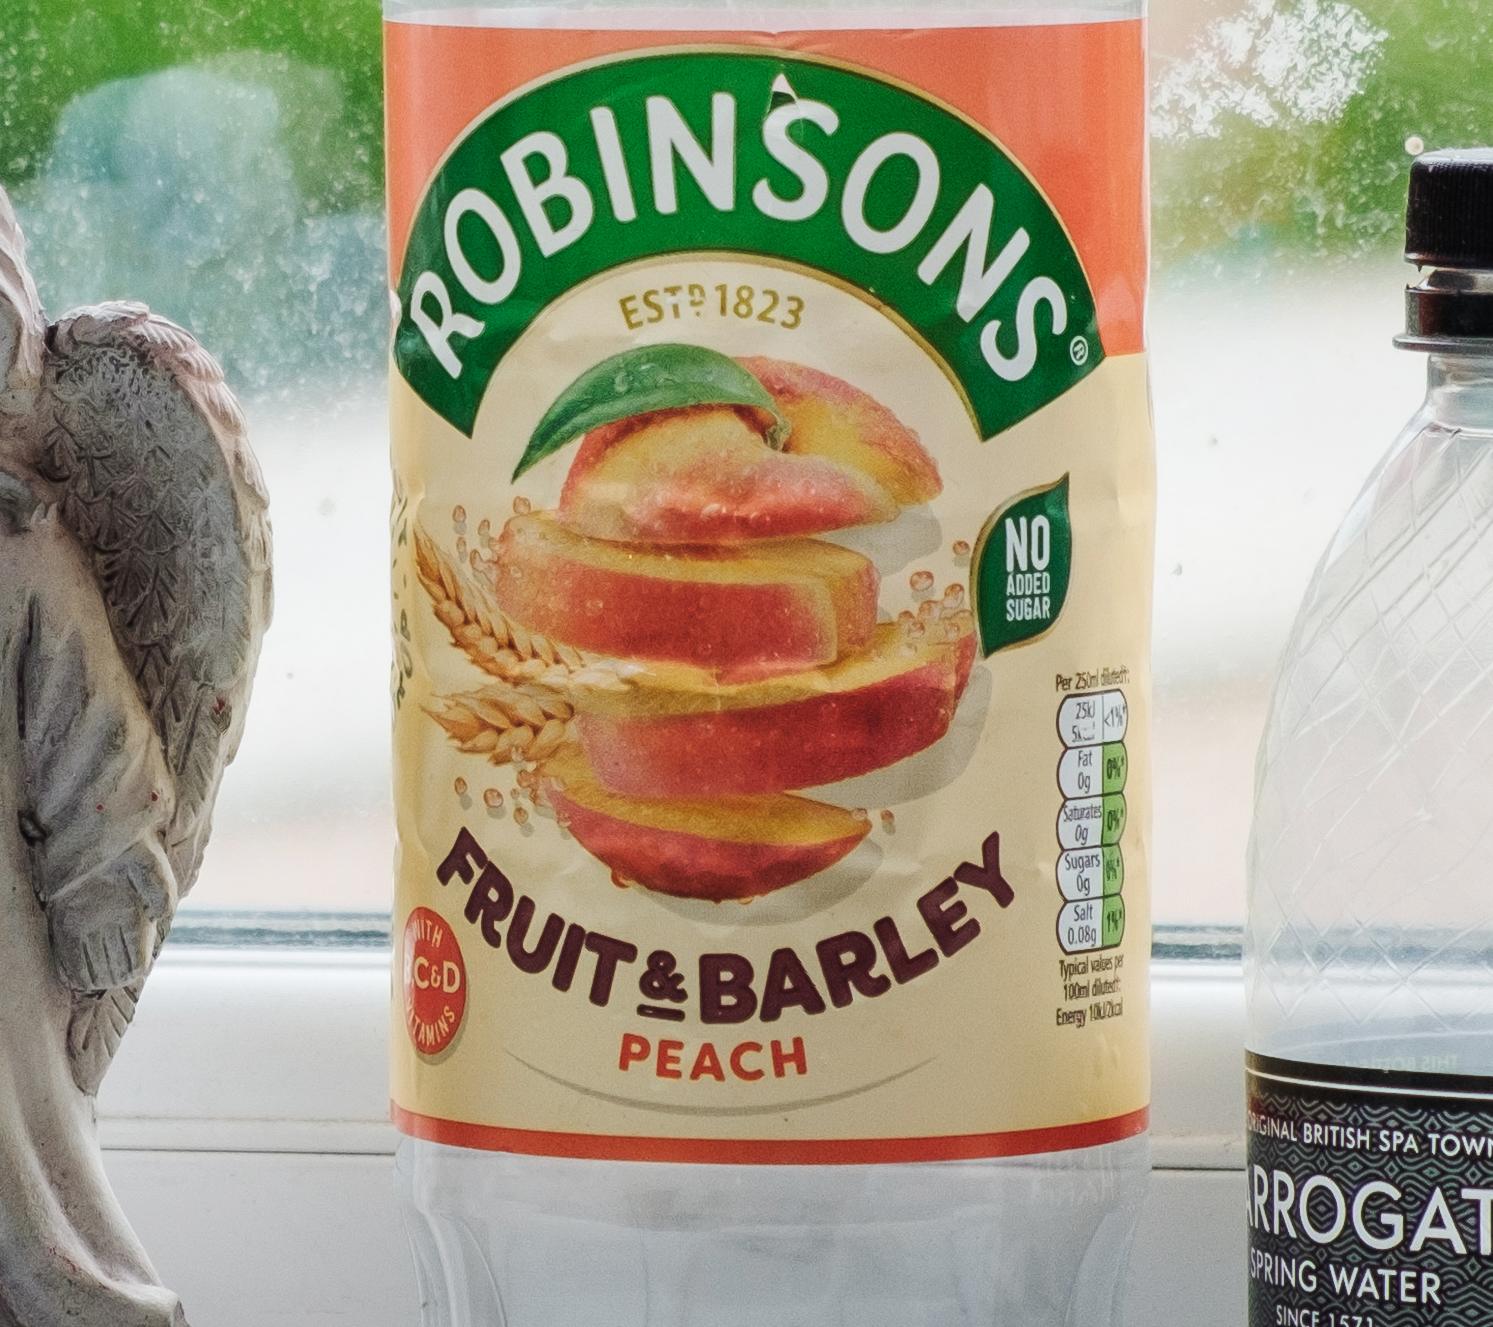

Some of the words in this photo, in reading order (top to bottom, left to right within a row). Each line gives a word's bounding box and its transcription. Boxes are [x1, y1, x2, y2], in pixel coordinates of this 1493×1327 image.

[410, 90, 1068, 382] ROBINSONS
[714, 283, 806, 331] 1823
[1004, 515, 1052, 573] NO
[1004, 571, 1051, 597] ADDED
[1004, 596, 1052, 622] SUGAR
[1056, 673, 1073, 692] Per
[1076, 700, 1096, 720] 25kJ
[1077, 750, 1093, 768] Fat
[1077, 772, 1091, 794] 0g
[1063, 804, 1103, 822] Saturates
[1074, 824, 1089, 846] 0g
[1064, 853, 1101, 874] Sugars
[1076, 874, 1091, 896] 0g
[1073, 902, 1094, 922] Salt
[436, 827, 638, 1008] FRUIT
[636, 950, 689, 1022] &
[699, 831, 1017, 1025] BARLEY
[1067, 926, 1097, 947] 0.08g
[1059, 956, 1089, 982] Typical
[1056, 1007, 1087, 1029] Energy
[617, 1034, 809, 1083] PEACH
[1302, 1122, 1371, 1151] BRITISH
[1378, 1131, 1420, 1154] SPA
[1250, 1249, 1318, 1293] SPRING
[1328, 1263, 1442, 1305] WATER
